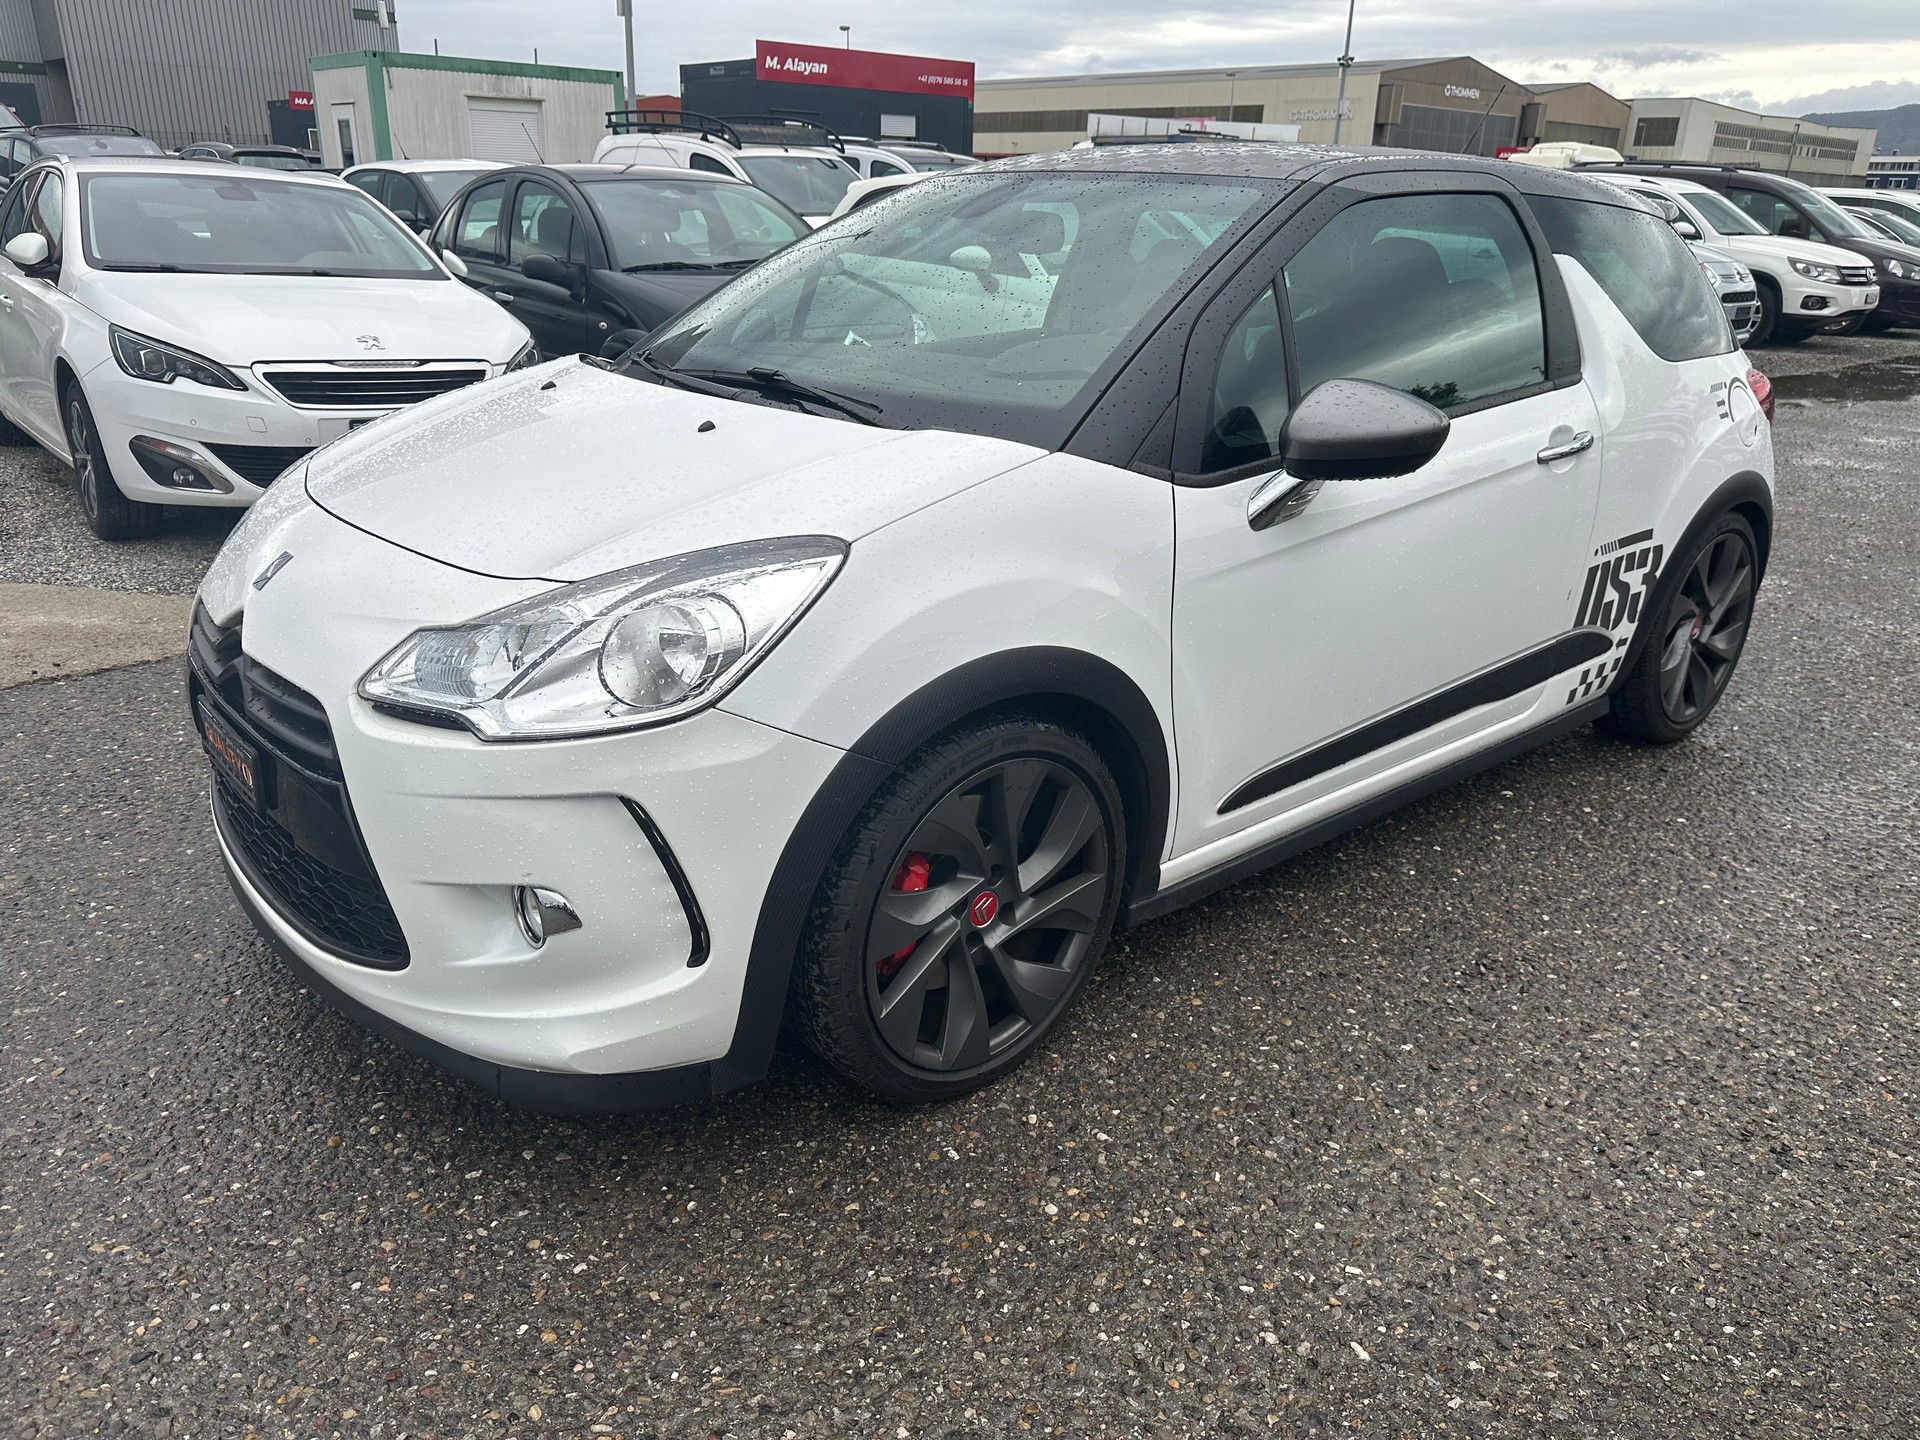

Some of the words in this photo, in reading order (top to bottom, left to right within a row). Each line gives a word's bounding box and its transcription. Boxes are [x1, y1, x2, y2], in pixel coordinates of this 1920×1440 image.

[765, 55, 781, 70] M.
[783, 57, 828, 75] Alayan
[1451, 86, 1480, 99] THOMMEN
[294, 97, 308, 105] MA
[1573, 544, 1663, 632] DS3
